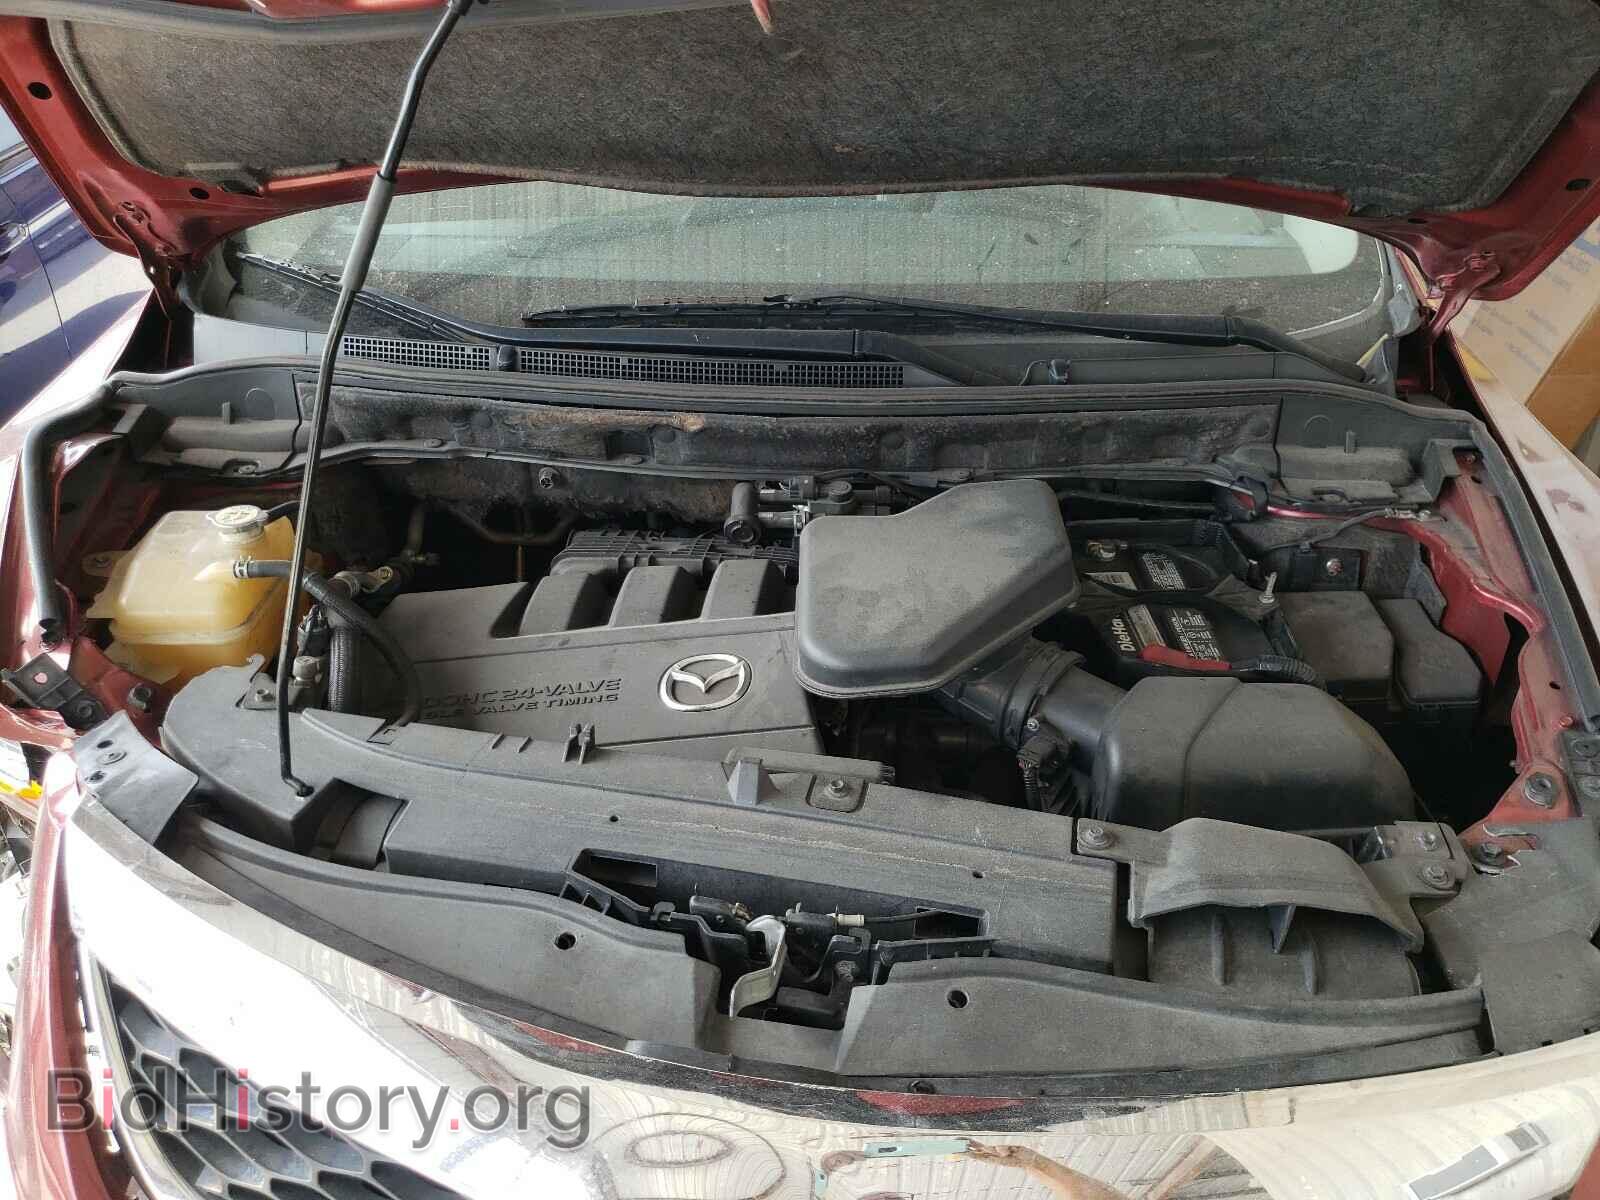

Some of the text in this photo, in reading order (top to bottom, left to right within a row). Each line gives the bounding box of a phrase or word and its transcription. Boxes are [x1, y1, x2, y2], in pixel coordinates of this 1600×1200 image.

[500, 678, 622, 702] 24-VALVE
[472, 701, 538, 716] VALVE
[544, 692, 619, 709] TIMING
